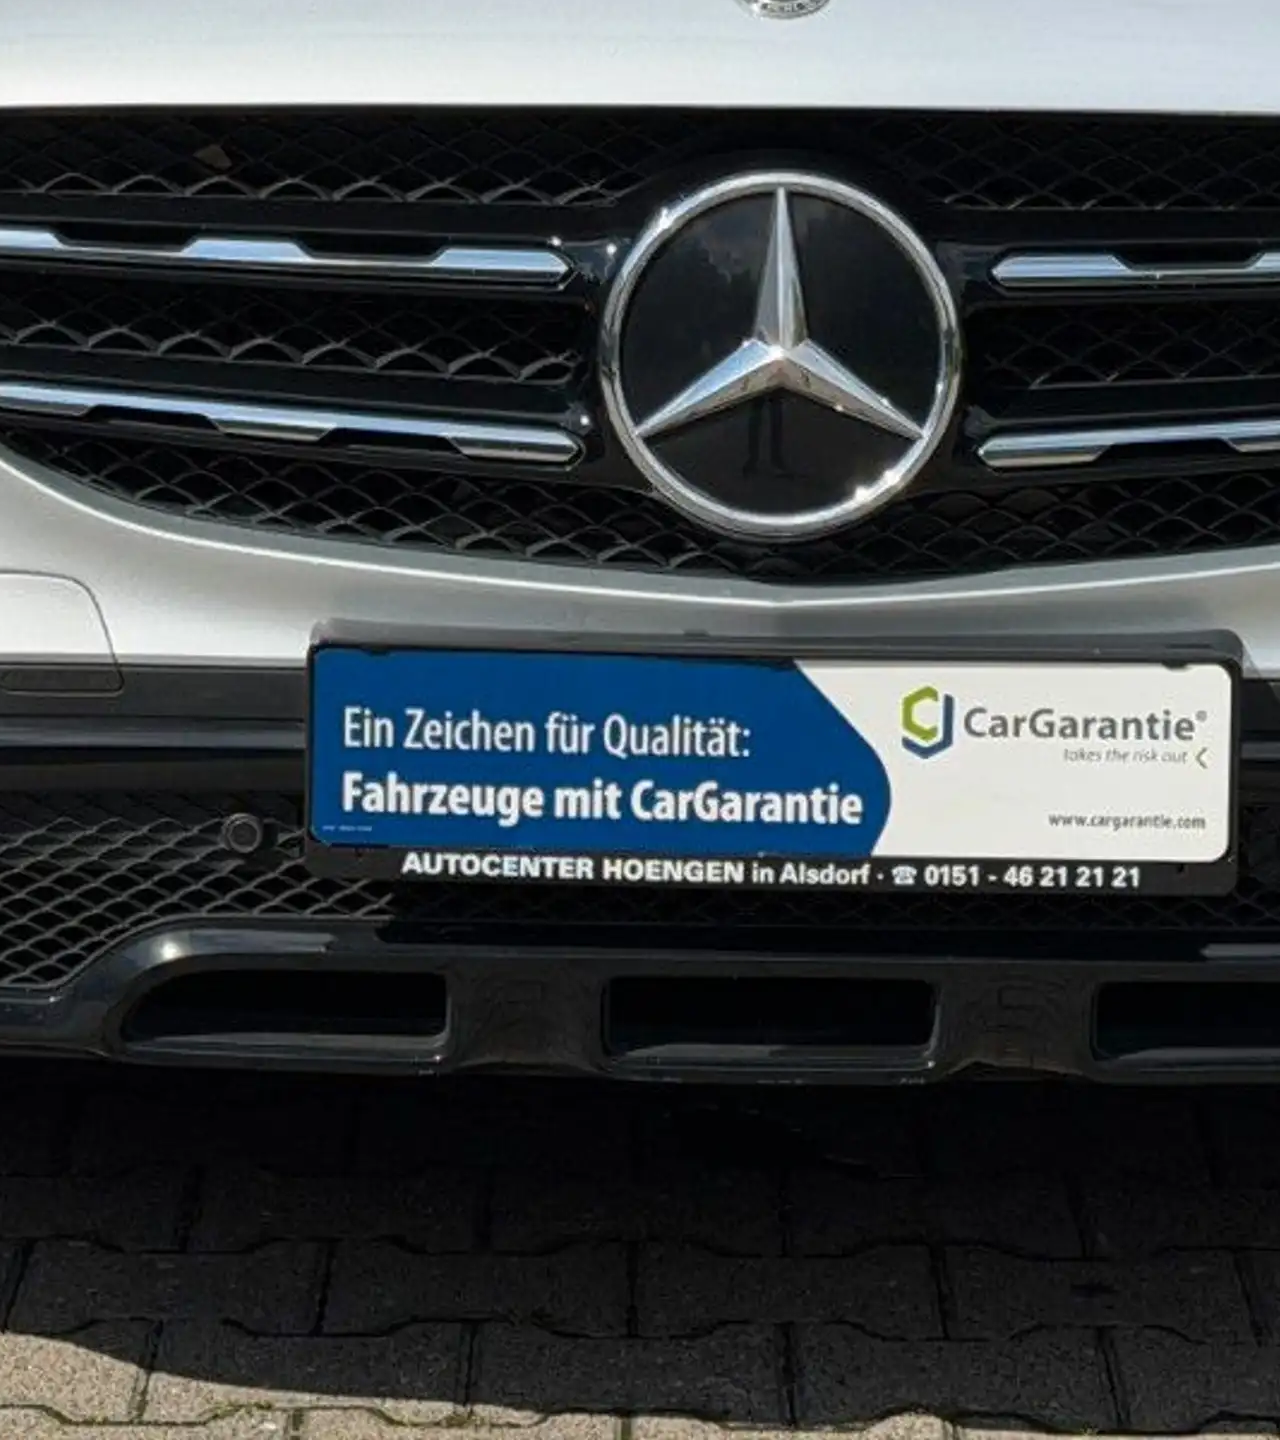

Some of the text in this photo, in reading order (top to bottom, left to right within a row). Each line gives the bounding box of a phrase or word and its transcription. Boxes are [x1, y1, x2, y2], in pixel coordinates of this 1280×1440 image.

[343, 705, 751, 759] Ein Zeichen für Qualität:
[1106, 747, 1129, 763] the
[1132, 748, 1157, 763] risk
[1161, 750, 1188, 764] out
[342, 770, 863, 827] Fahrzeuge mit CarGarantie
[1048, 813, 1206, 831] www.cargarantie.com
[401, 851, 594, 880] AUTOCENTER
[603, 858, 744, 883] HOENGEN
[752, 862, 774, 883] in
[779, 862, 871, 885] Alsdorf
[924, 864, 980, 887] 0151
[1002, 864, 1033, 887] 46
[1039, 864, 1068, 888] 21
[1075, 865, 1104, 888] 21
[1111, 866, 1140, 888] 21
